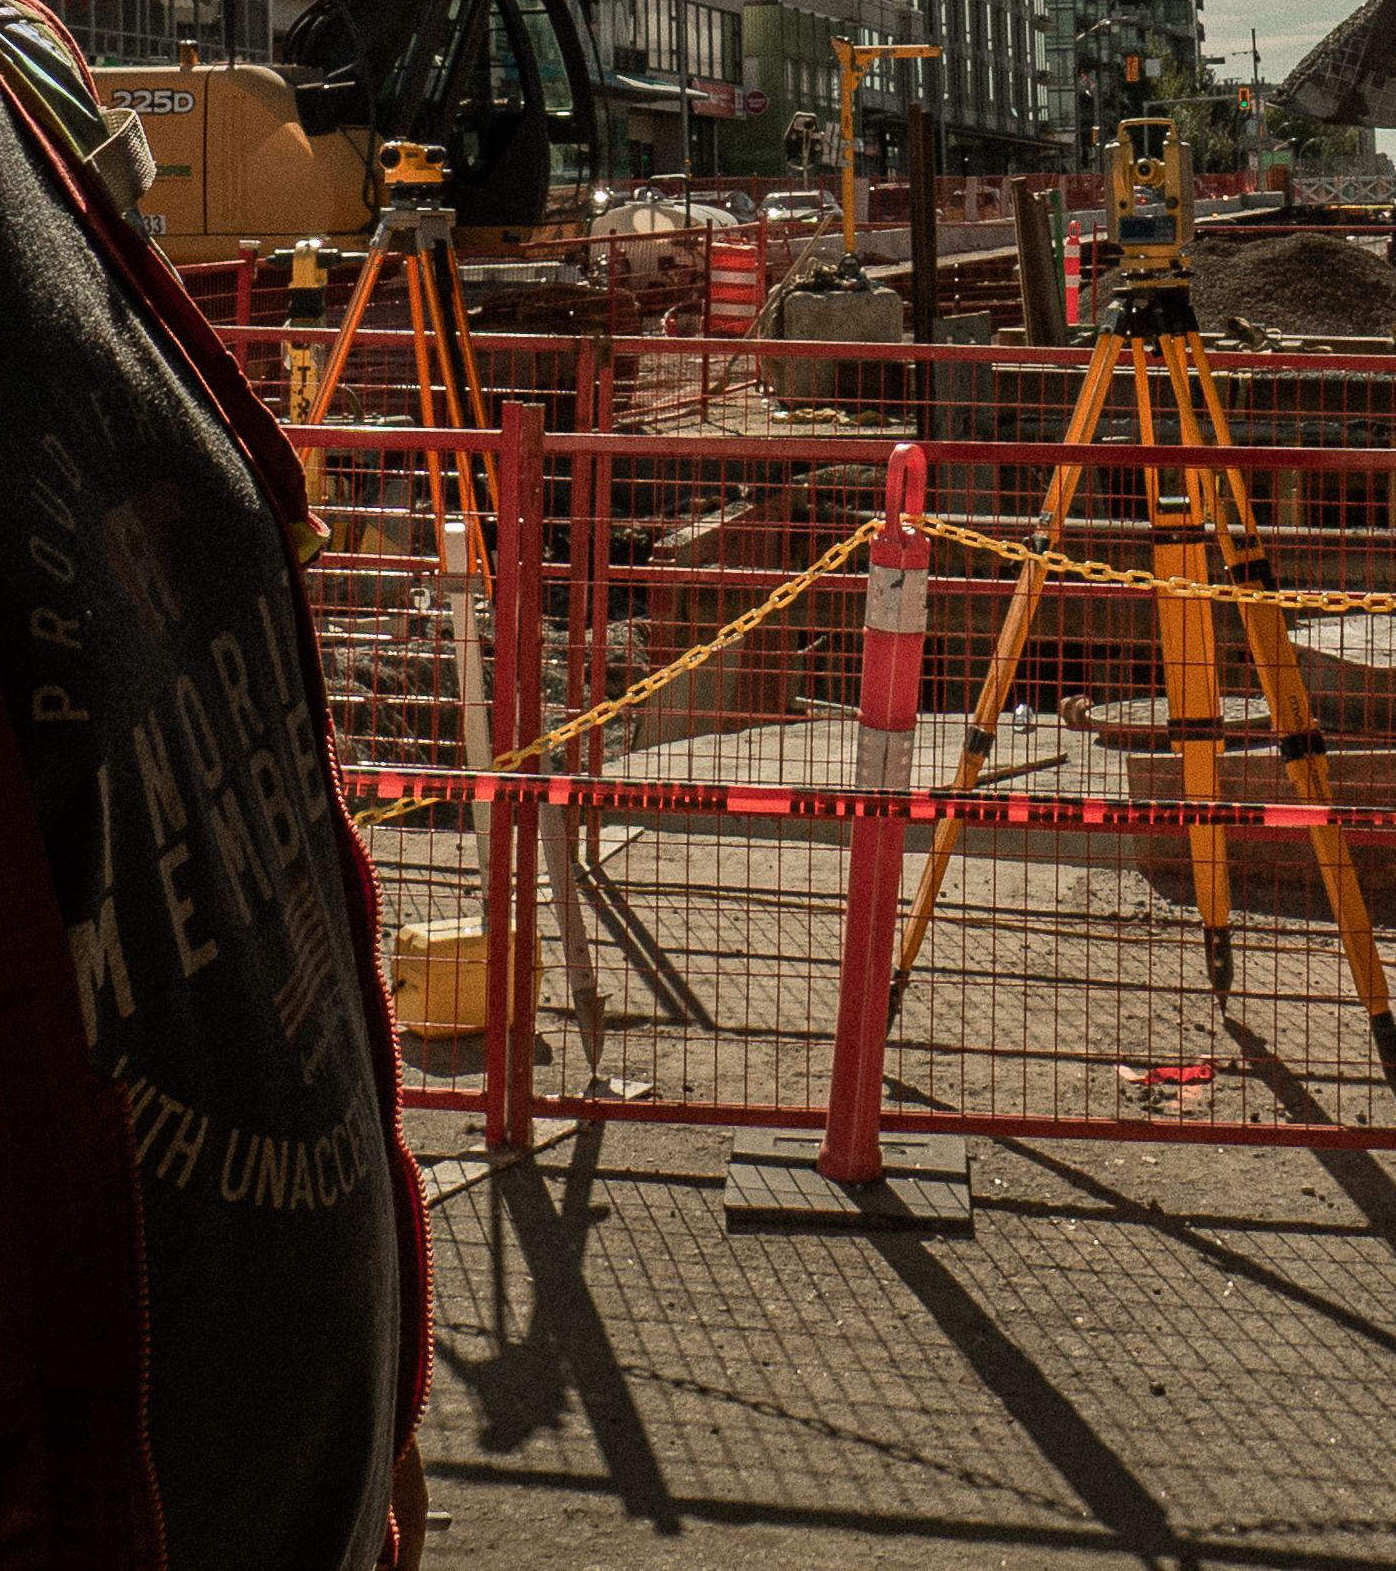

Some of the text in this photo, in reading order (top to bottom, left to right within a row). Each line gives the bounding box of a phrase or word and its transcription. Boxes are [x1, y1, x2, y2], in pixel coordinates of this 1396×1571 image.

[111, 87, 196, 115] 225D
[27, 433, 90, 722] PROUD
[96, 572, 293, 890] INORI
